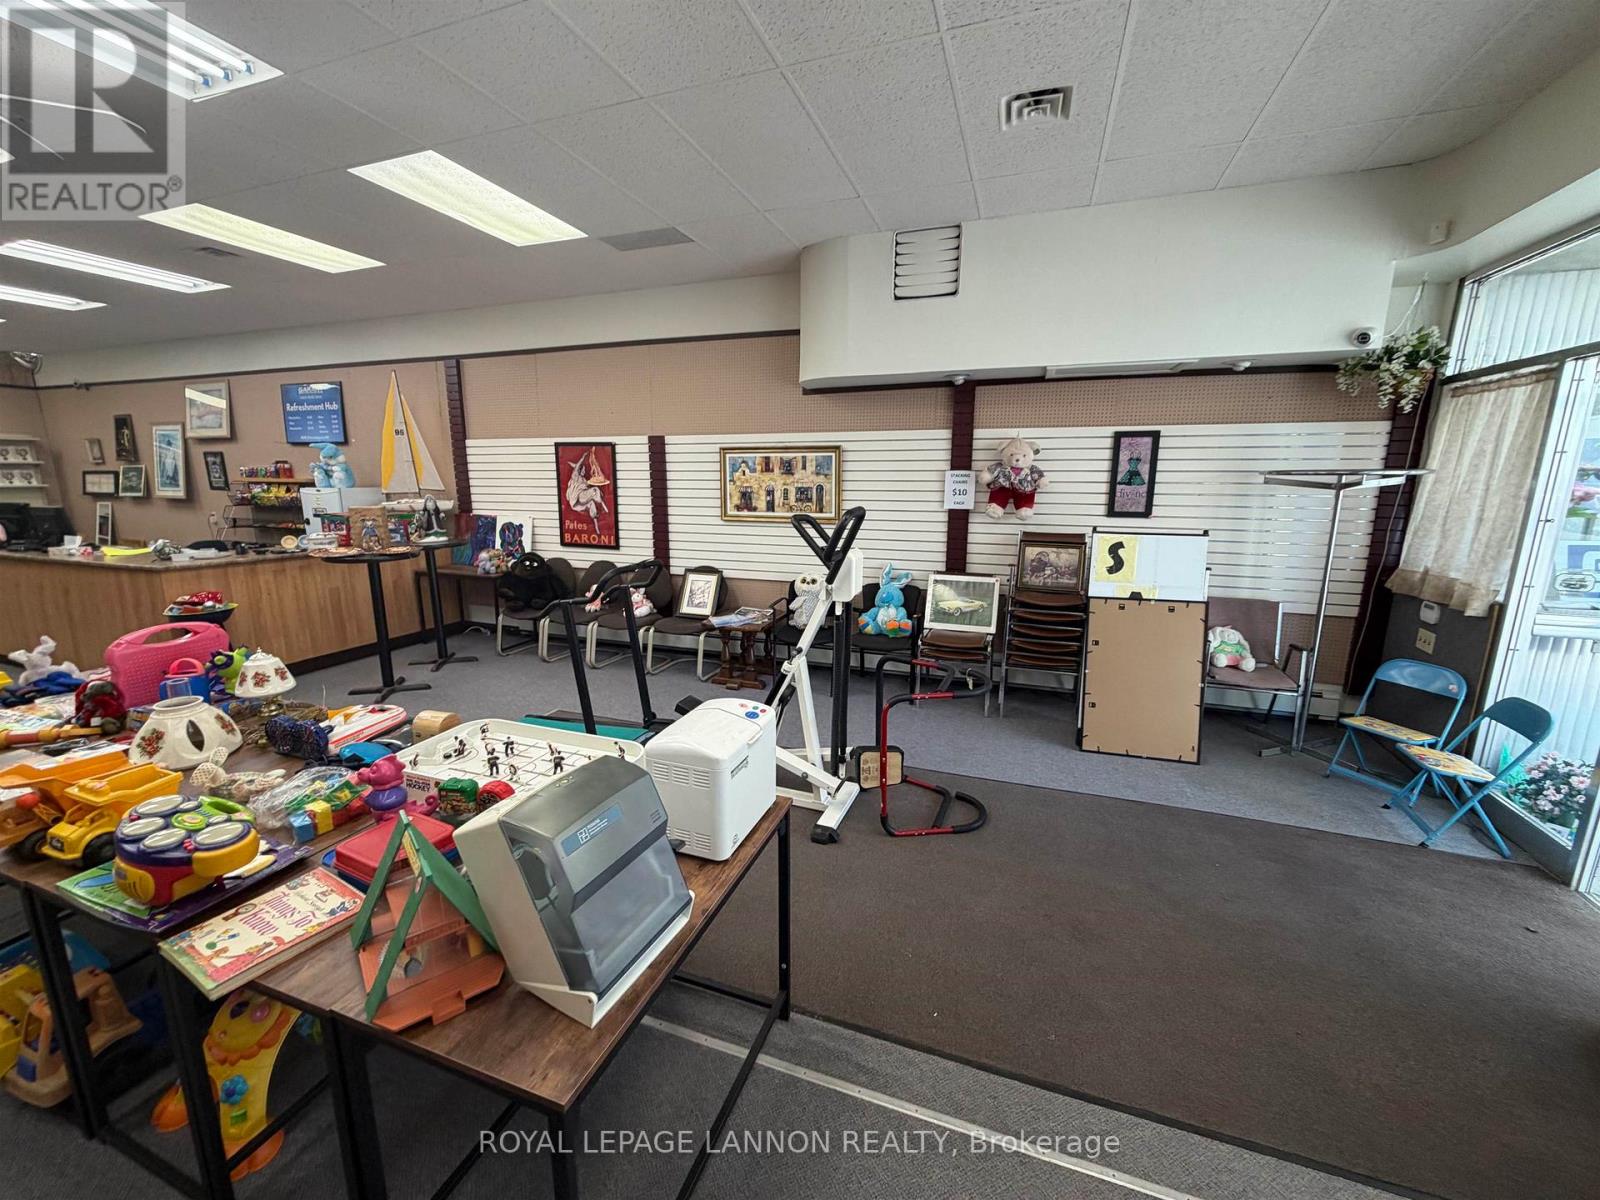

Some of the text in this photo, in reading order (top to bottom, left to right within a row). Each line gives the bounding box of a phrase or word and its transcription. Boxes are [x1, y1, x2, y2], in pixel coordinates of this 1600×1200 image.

[286, 401, 338, 411] Refreshment Hub
[952, 487, 968, 497] $10
[564, 533, 615, 545] BARONI
[1105, 541, 1126, 575] S
